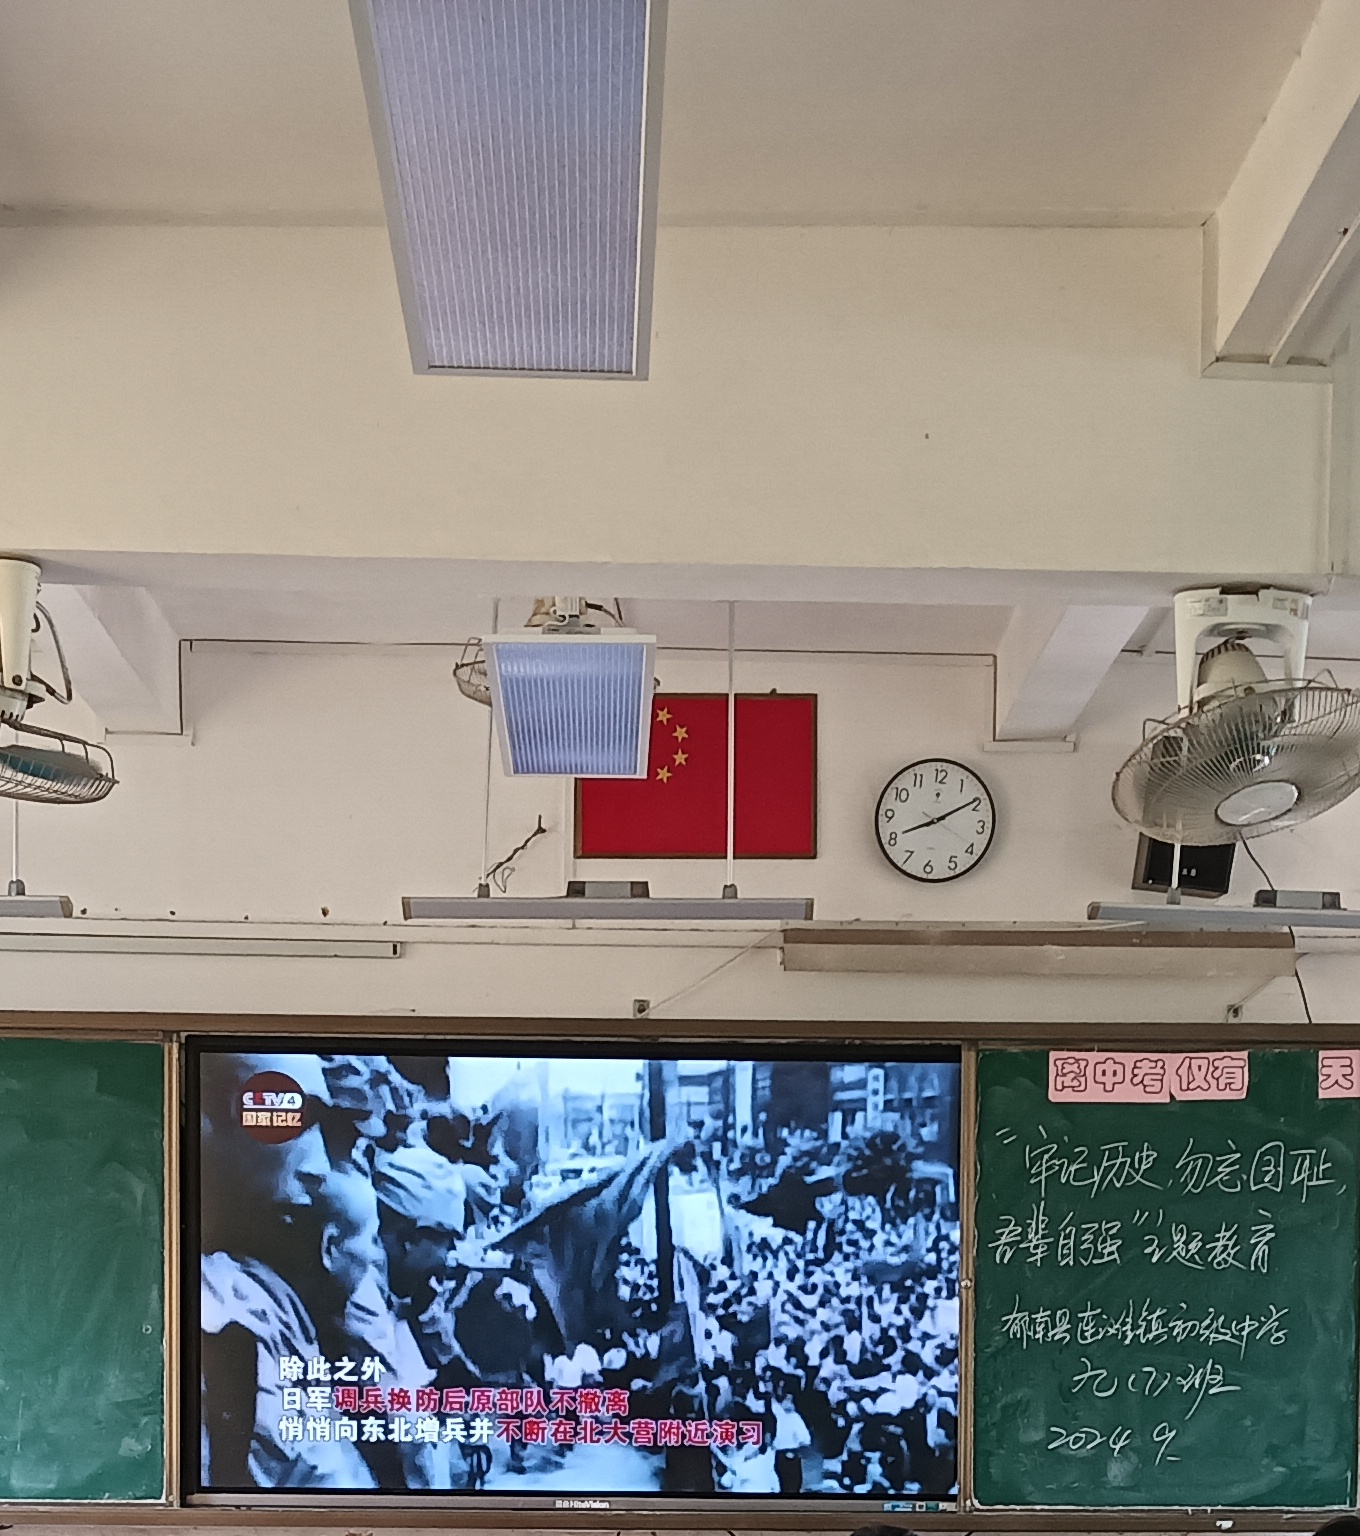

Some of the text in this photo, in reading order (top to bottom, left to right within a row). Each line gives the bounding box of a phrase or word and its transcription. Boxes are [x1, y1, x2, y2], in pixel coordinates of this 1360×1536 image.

[913, 773, 923, 788] 11
[935, 768, 948, 784] 12
[959, 779, 964, 793] 1
[893, 787, 909, 802] 10
[971, 797, 982, 811] 2
[885, 809, 895, 823] 9
[975, 820, 986, 835] 3
[888, 831, 898, 846] 8
[965, 843, 975, 855] 4
[903, 850, 914, 865] 7
[948, 855, 958, 871] 5
[923, 860, 934, 874] 6
[1320, 1057, 1354, 1091] 天
[279, 1356, 386, 1382] 除此之外
[282, 1386, 629, 1416] 日军调兵换防后原部队不撤离
[278, 1415, 763, 1447] 悄悄向东北增兵并不断在北大营附近演习
